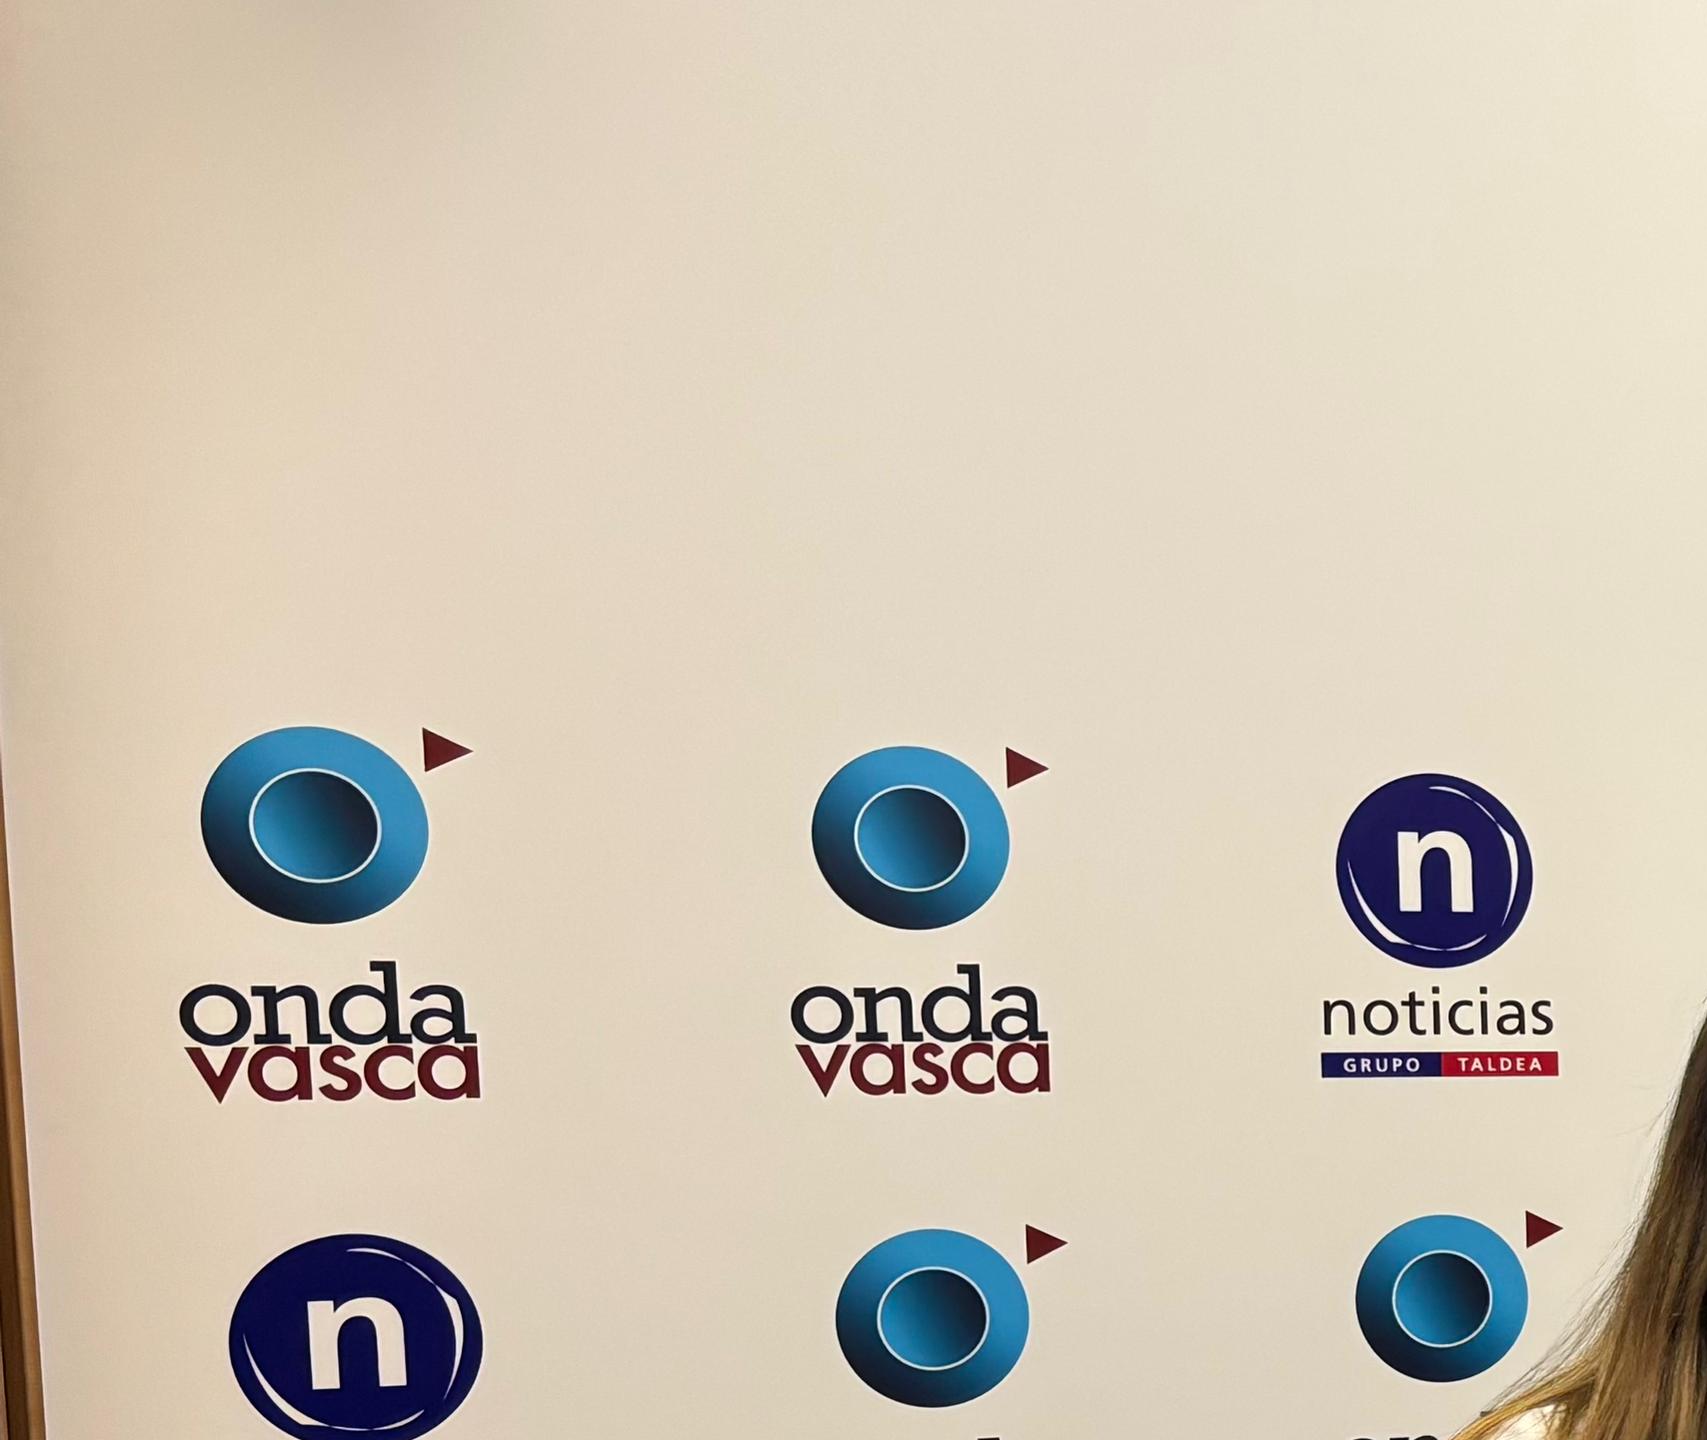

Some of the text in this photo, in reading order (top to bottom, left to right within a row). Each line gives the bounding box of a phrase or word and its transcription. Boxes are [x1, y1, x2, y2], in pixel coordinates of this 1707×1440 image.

[1397, 828, 1474, 913] n
[179, 961, 477, 1046] onda
[791, 964, 1047, 1044] onda
[1323, 986, 1554, 1036] noticias
[184, 1043, 480, 1104] vasca
[794, 1042, 1051, 1098] vasca
[1343, 1055, 1543, 1074] GRUPO TALDEA
[307, 1296, 407, 1391] n
